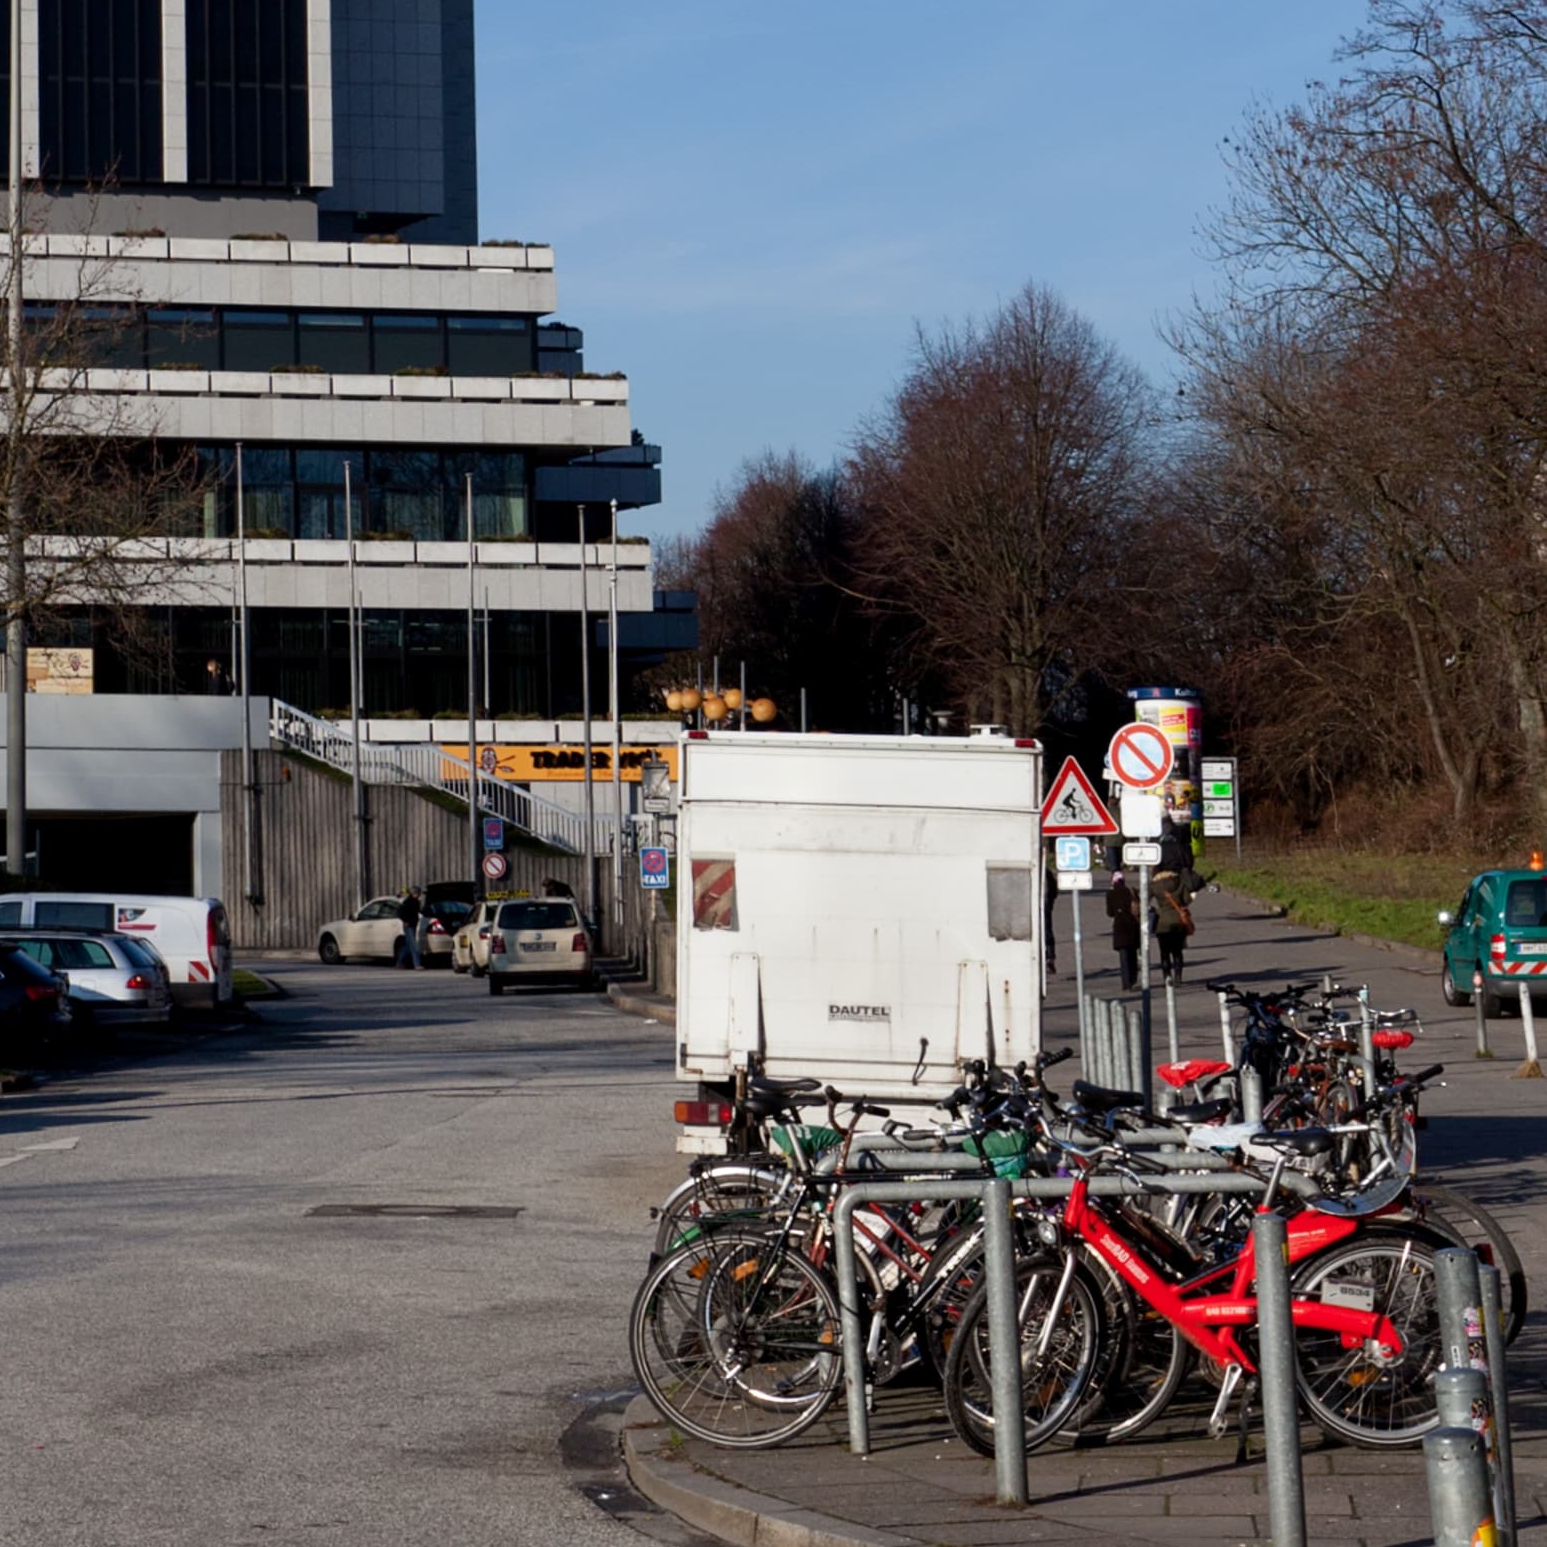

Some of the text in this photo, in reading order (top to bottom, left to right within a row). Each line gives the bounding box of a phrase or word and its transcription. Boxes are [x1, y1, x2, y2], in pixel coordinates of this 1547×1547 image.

[1063, 841, 1081, 866] P
[644, 874, 666, 885] TAXI
[829, 1004, 890, 1016] DAUTEL
